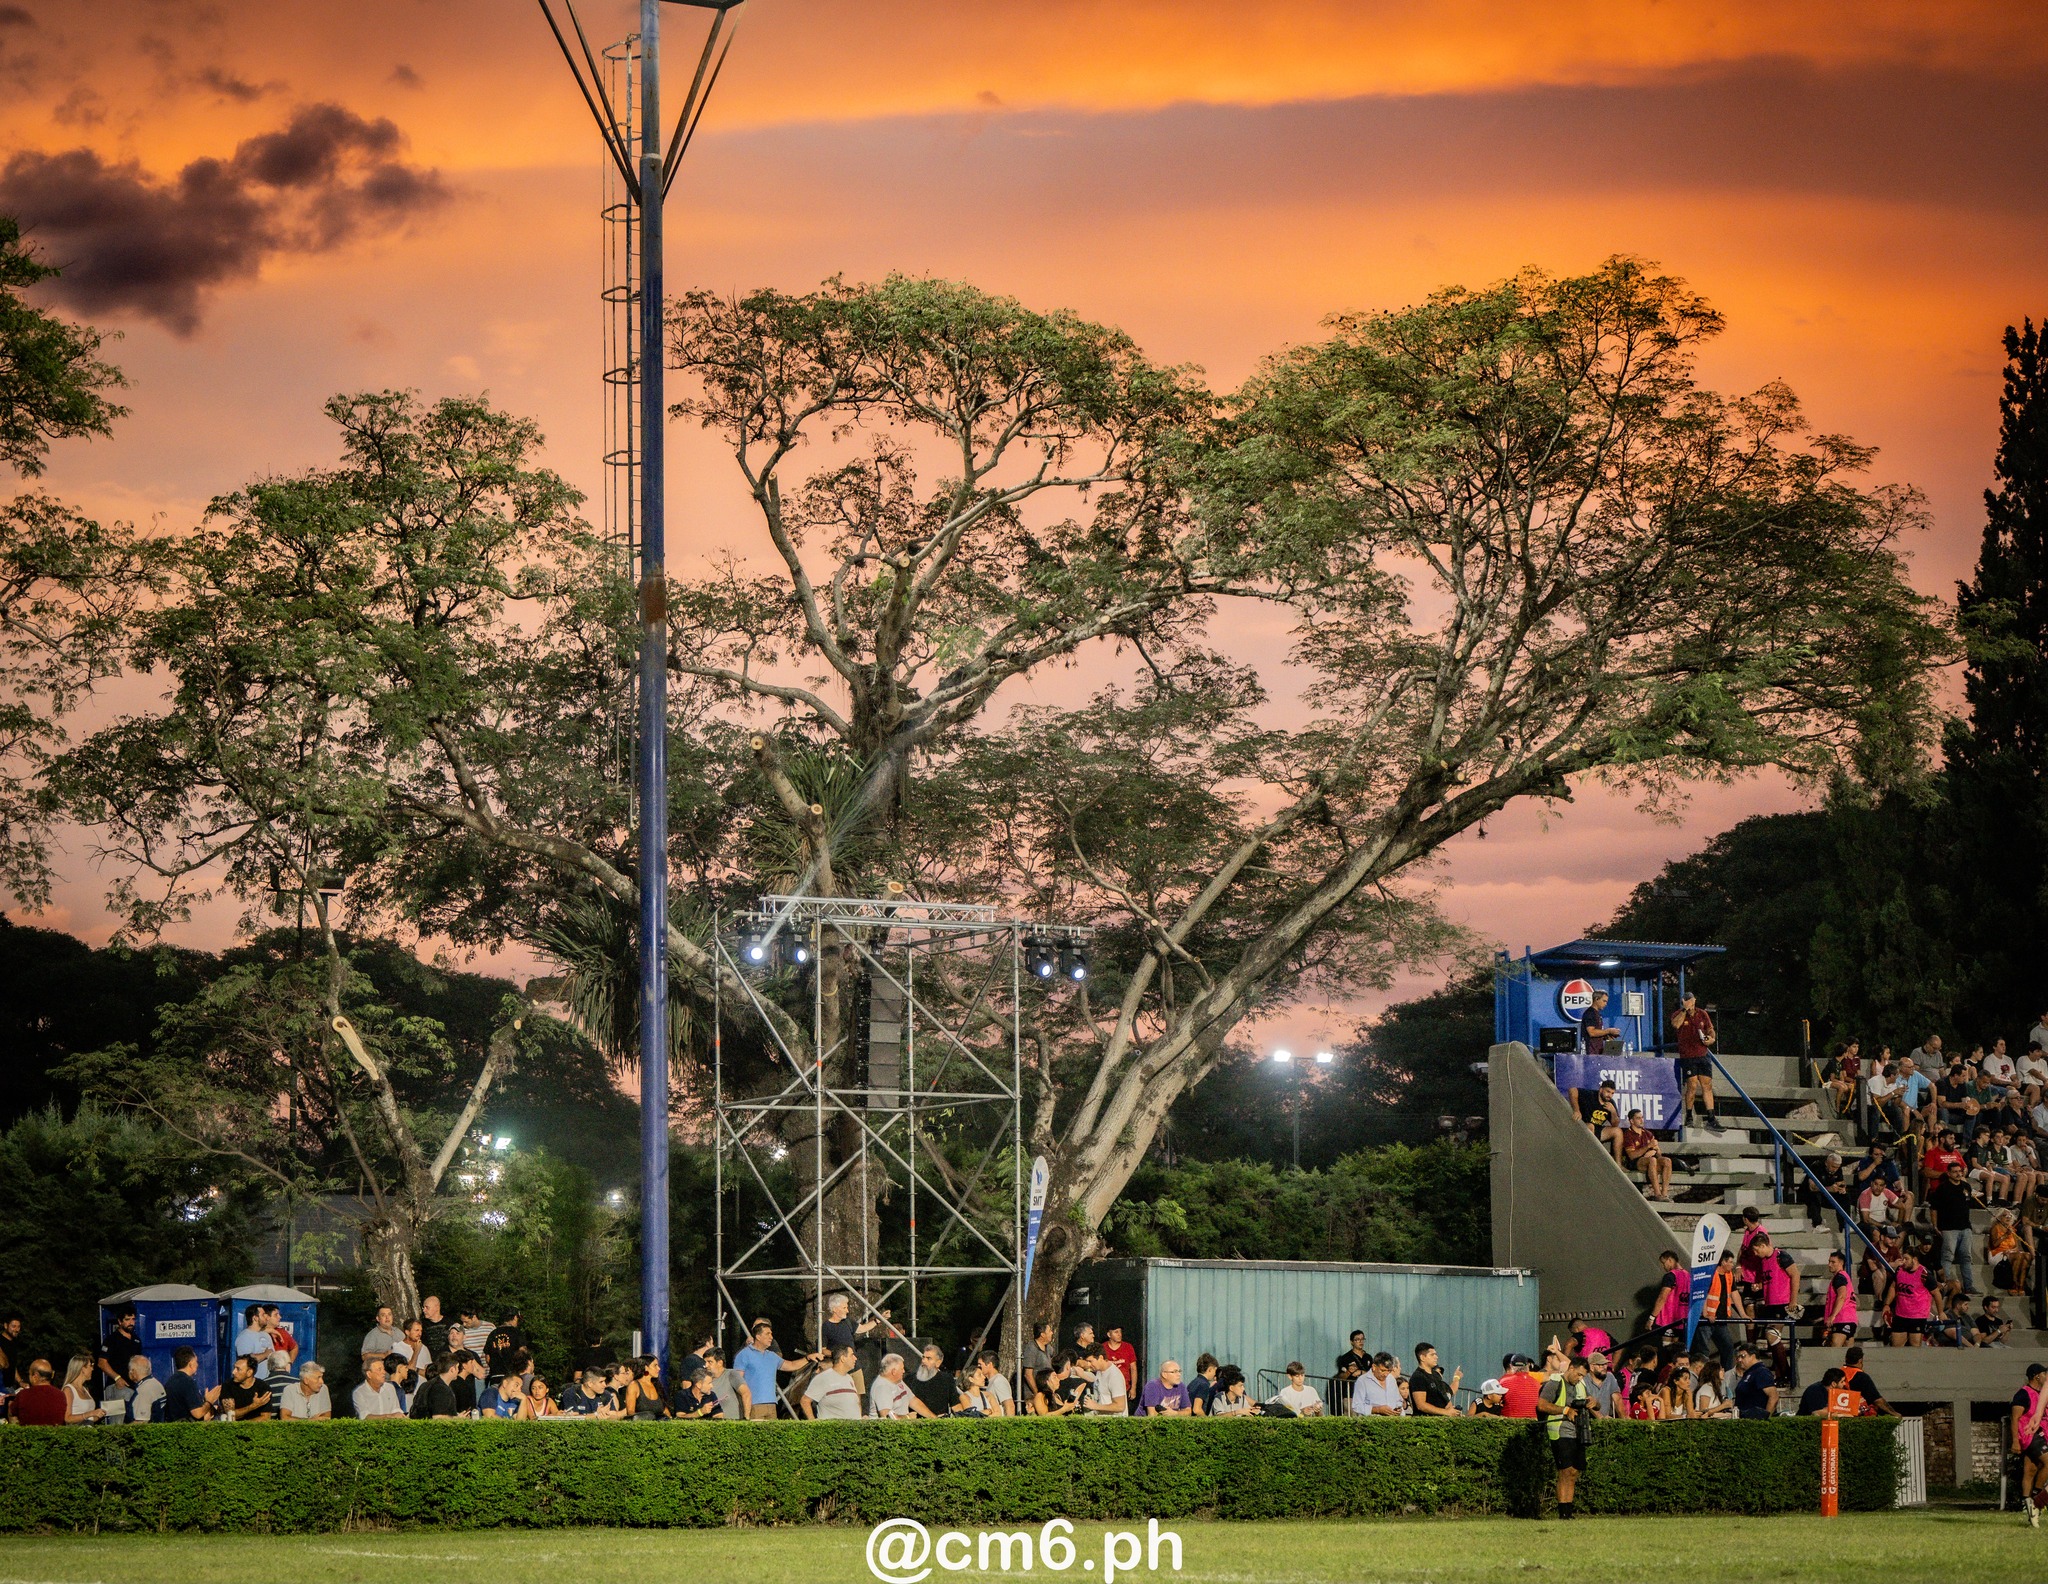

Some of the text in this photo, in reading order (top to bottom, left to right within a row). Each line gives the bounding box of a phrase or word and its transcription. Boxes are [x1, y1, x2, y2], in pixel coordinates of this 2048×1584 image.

[1564, 996, 1592, 1005] PEPS
[1600, 1069, 1639, 1090] STAFF
[1613, 1094, 1664, 1121] TANTE
[1697, 1251, 1716, 1263] SMT
[168, 1322, 192, 1331] Basani
[1837, 1392, 1850, 1407] G
